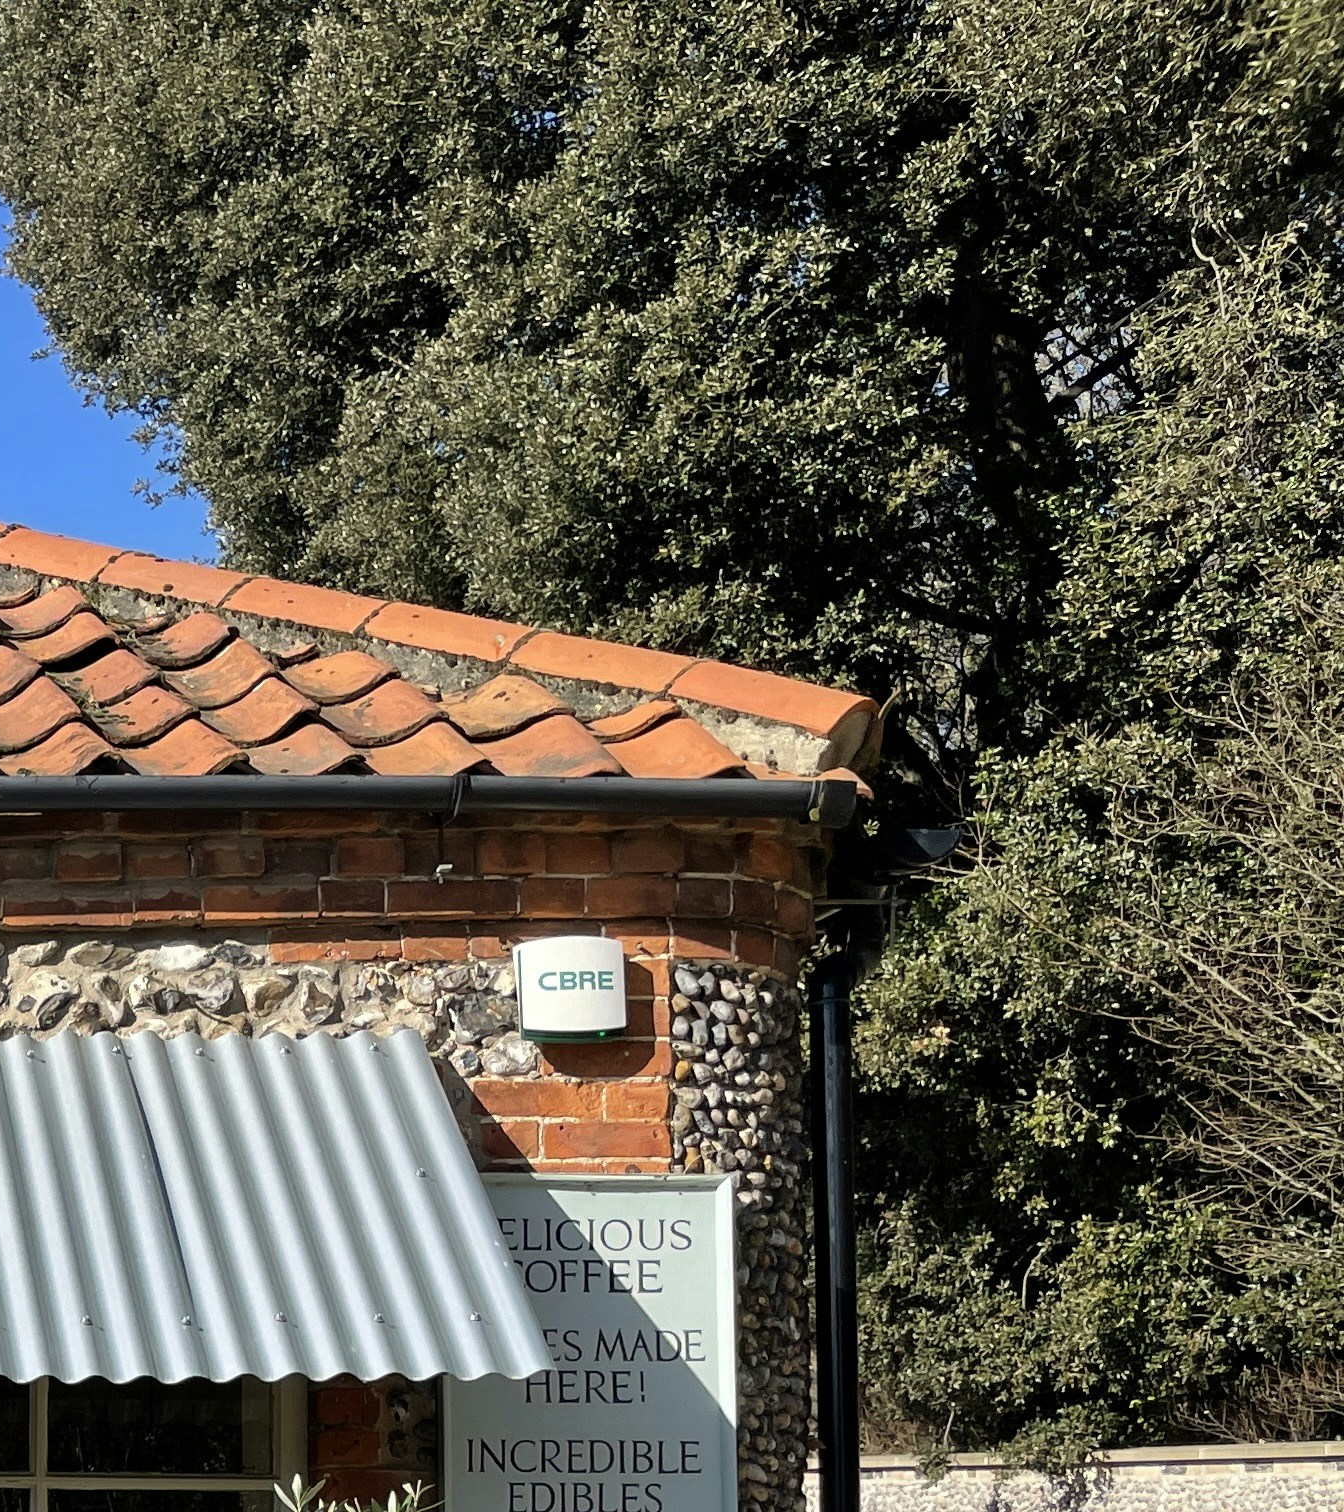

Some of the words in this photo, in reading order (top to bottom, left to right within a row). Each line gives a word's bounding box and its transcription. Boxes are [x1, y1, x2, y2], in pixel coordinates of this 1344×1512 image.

[537, 970, 614, 991] CBRE
[497, 1217, 693, 1252] ELICIOUS
[594, 1328, 706, 1363] MADE
[524, 1369, 646, 1404] HERE!
[466, 1438, 702, 1474] INCREDIBLE
